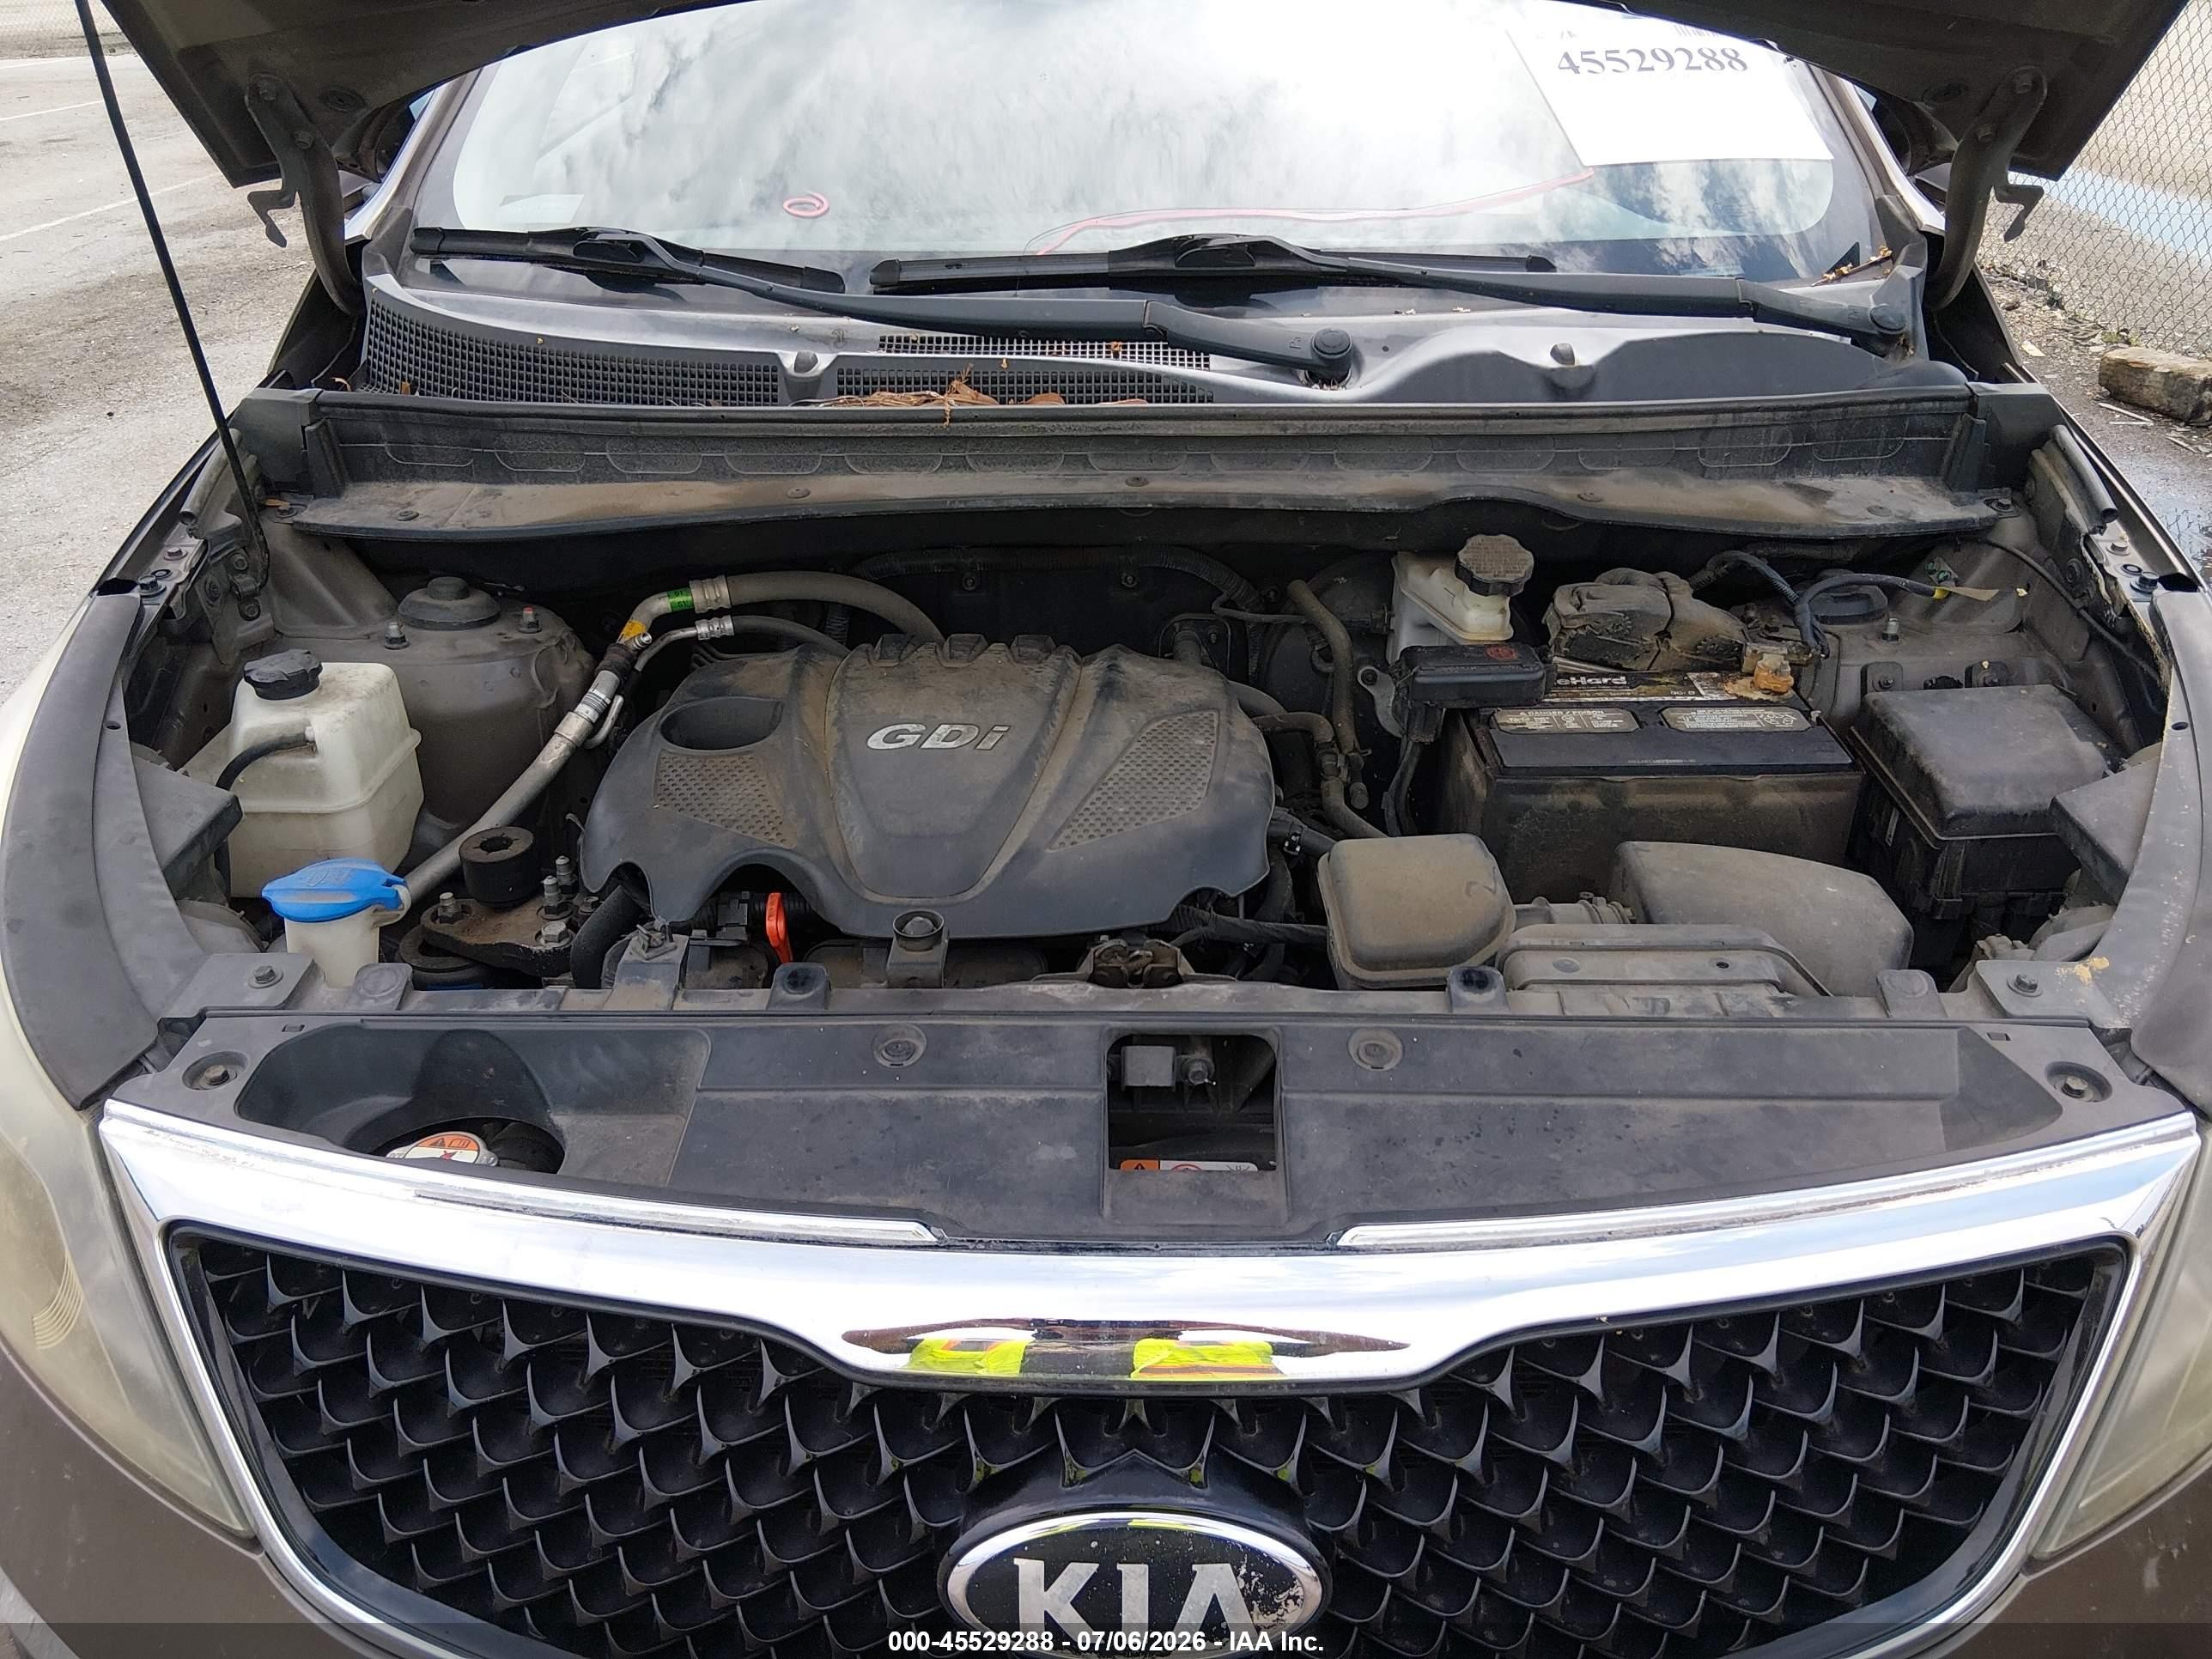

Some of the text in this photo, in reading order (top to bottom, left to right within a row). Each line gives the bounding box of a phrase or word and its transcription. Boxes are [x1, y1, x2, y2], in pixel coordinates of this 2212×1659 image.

[1558, 47, 1747, 75] 45529288
[866, 723, 1010, 750] GDi
[1013, 1558, 1262, 1644] KIA
